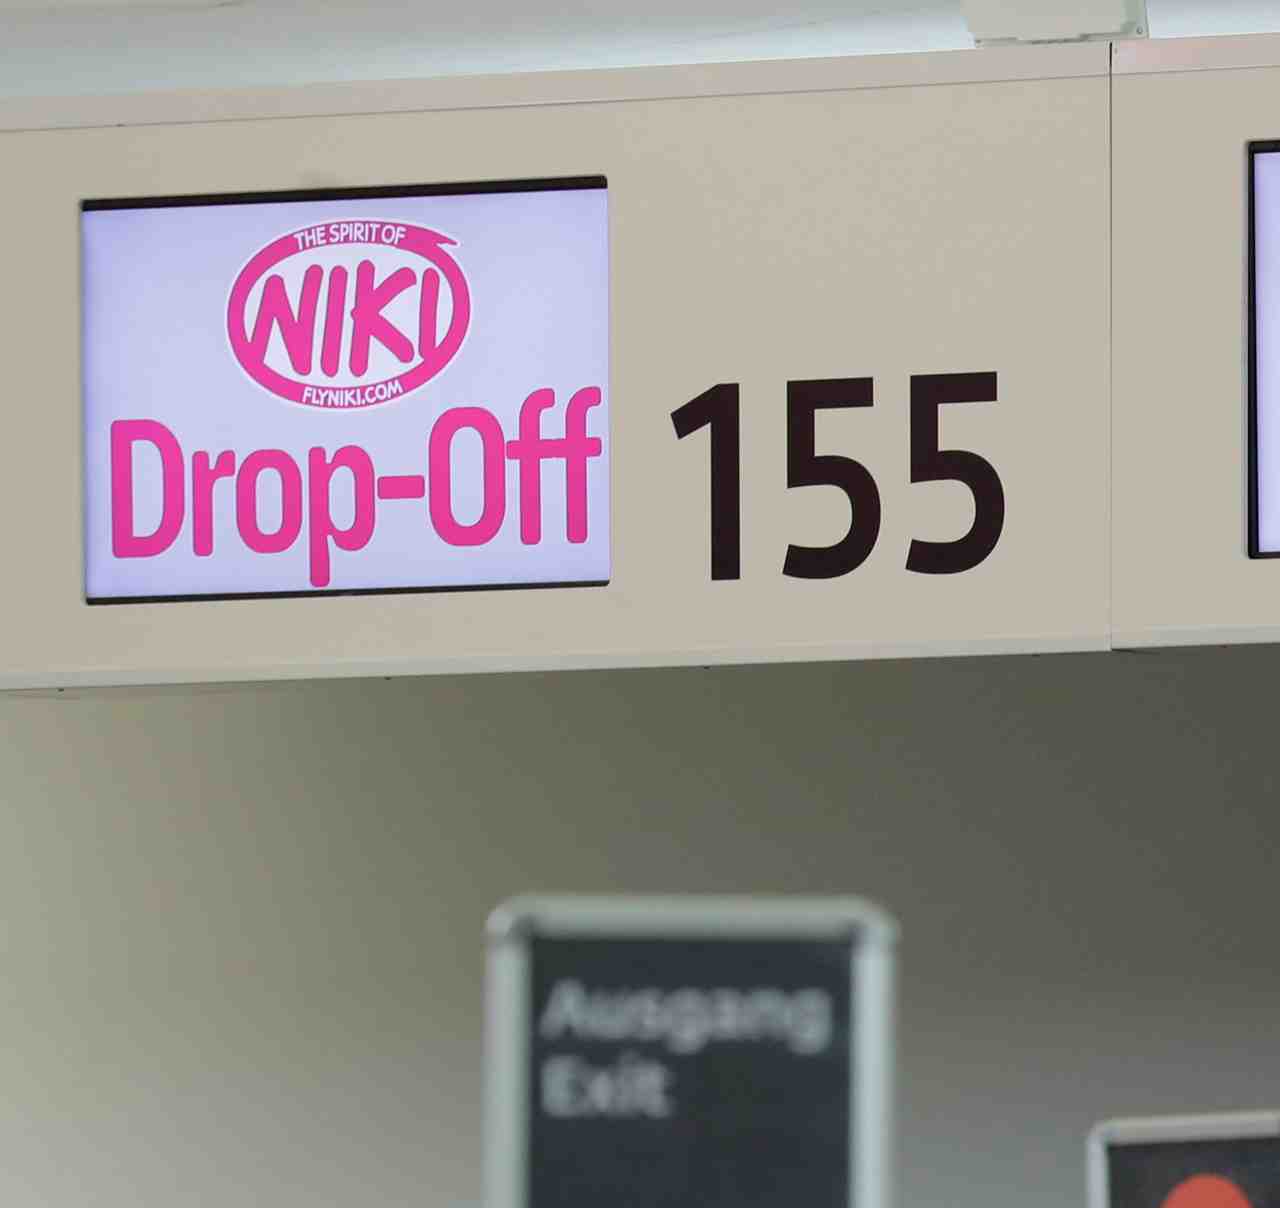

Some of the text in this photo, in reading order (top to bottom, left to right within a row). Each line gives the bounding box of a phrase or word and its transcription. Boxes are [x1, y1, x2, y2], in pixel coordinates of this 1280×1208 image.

[293, 222, 406, 250] THE SPIRIT OF
[247, 259, 440, 378] NIKI
[302, 379, 403, 407] FLYNIKI.COM
[110, 386, 602, 587] Drop-Off
[670, 371, 1005, 581] 155
[540, 979, 832, 1055] Ausgang
[541, 1053, 671, 1118] Exit
